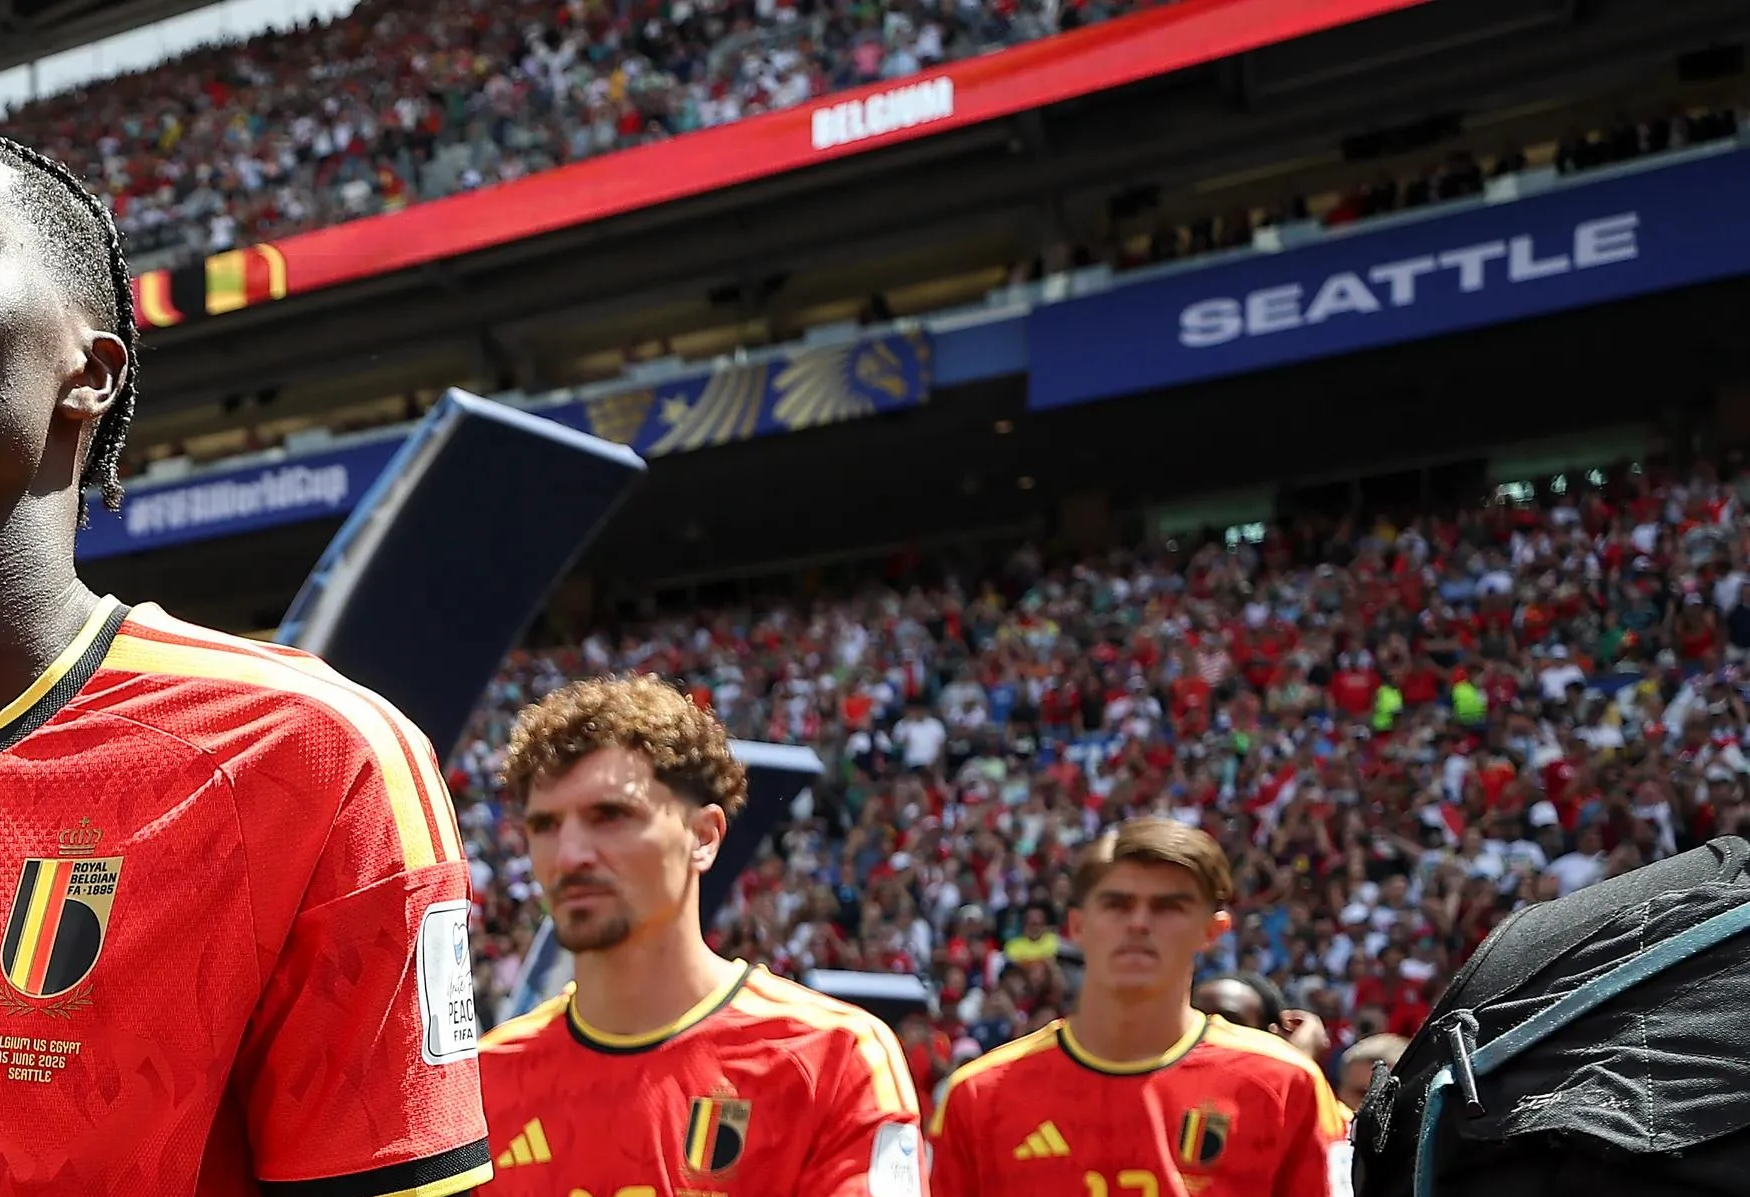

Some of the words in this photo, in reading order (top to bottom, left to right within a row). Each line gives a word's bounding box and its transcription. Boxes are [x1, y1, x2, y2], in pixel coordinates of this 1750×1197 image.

[1179, 211, 1641, 348] SEATTLE
[73, 862, 107, 872] ROYAL
[70, 873, 117, 884] BELGIAN
[448, 998, 474, 1025] PEAC
[453, 1028, 473, 1042] FIFA
[50, 1040, 81, 1054] EGYPT
[11, 1052, 35, 1066] JUNE
[38, 1054, 66, 1068] 2026
[8, 1067, 52, 1082] SEATTLE
